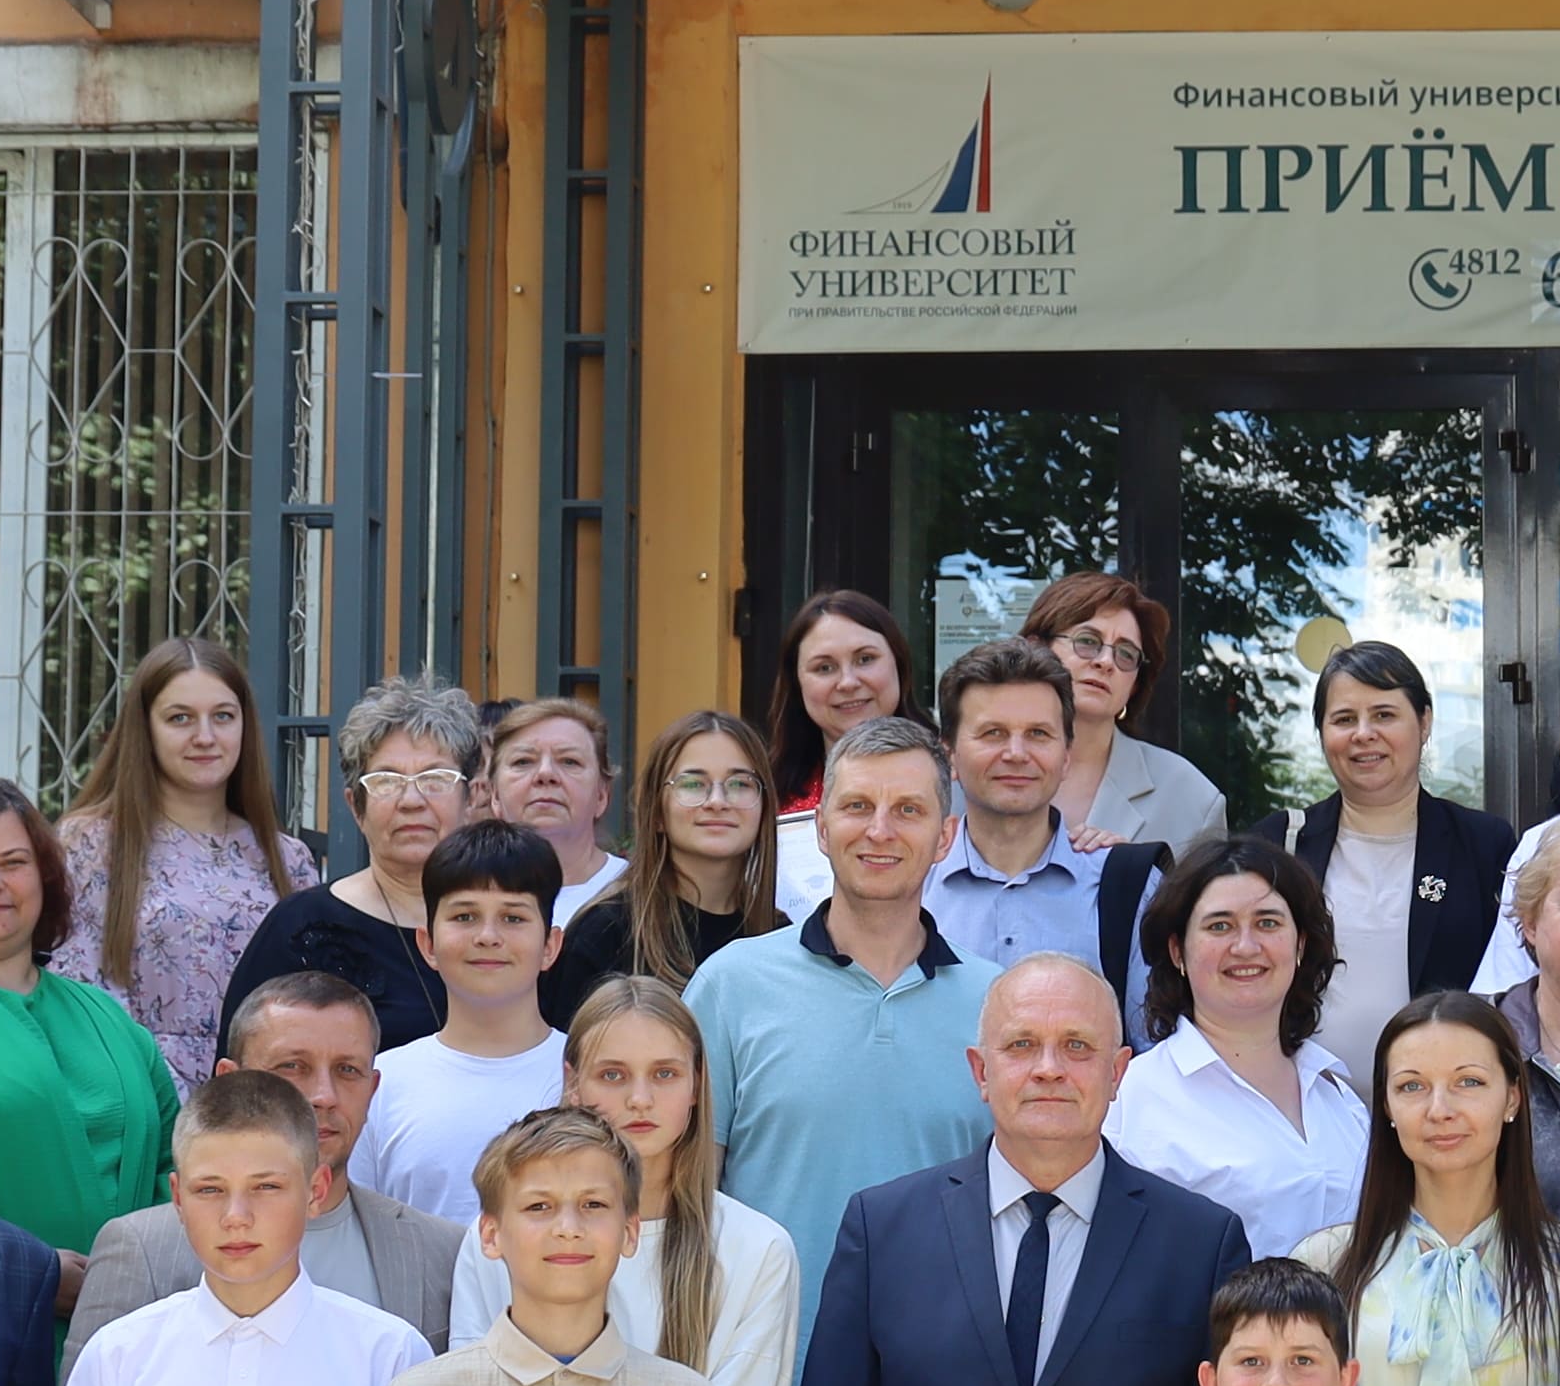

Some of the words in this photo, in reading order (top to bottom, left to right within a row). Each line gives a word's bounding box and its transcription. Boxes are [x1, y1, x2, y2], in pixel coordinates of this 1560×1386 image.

[1172, 78, 1400, 111] Финансовый
[789, 219, 1077, 258] ФИНАНСОВЫЙ
[1448, 248, 1521, 275] 4812
[789, 268, 1077, 299] УНИВЕРСИТЕТ
[789, 307, 814, 317] ПРИ
[816, 306, 916, 318] ПРАВИТЕЛЬСТВЕ
[918, 305, 1001, 317] РОССИЙСКОЙ
[1002, 304, 1078, 317] ФЕДЕРАЦИИ
